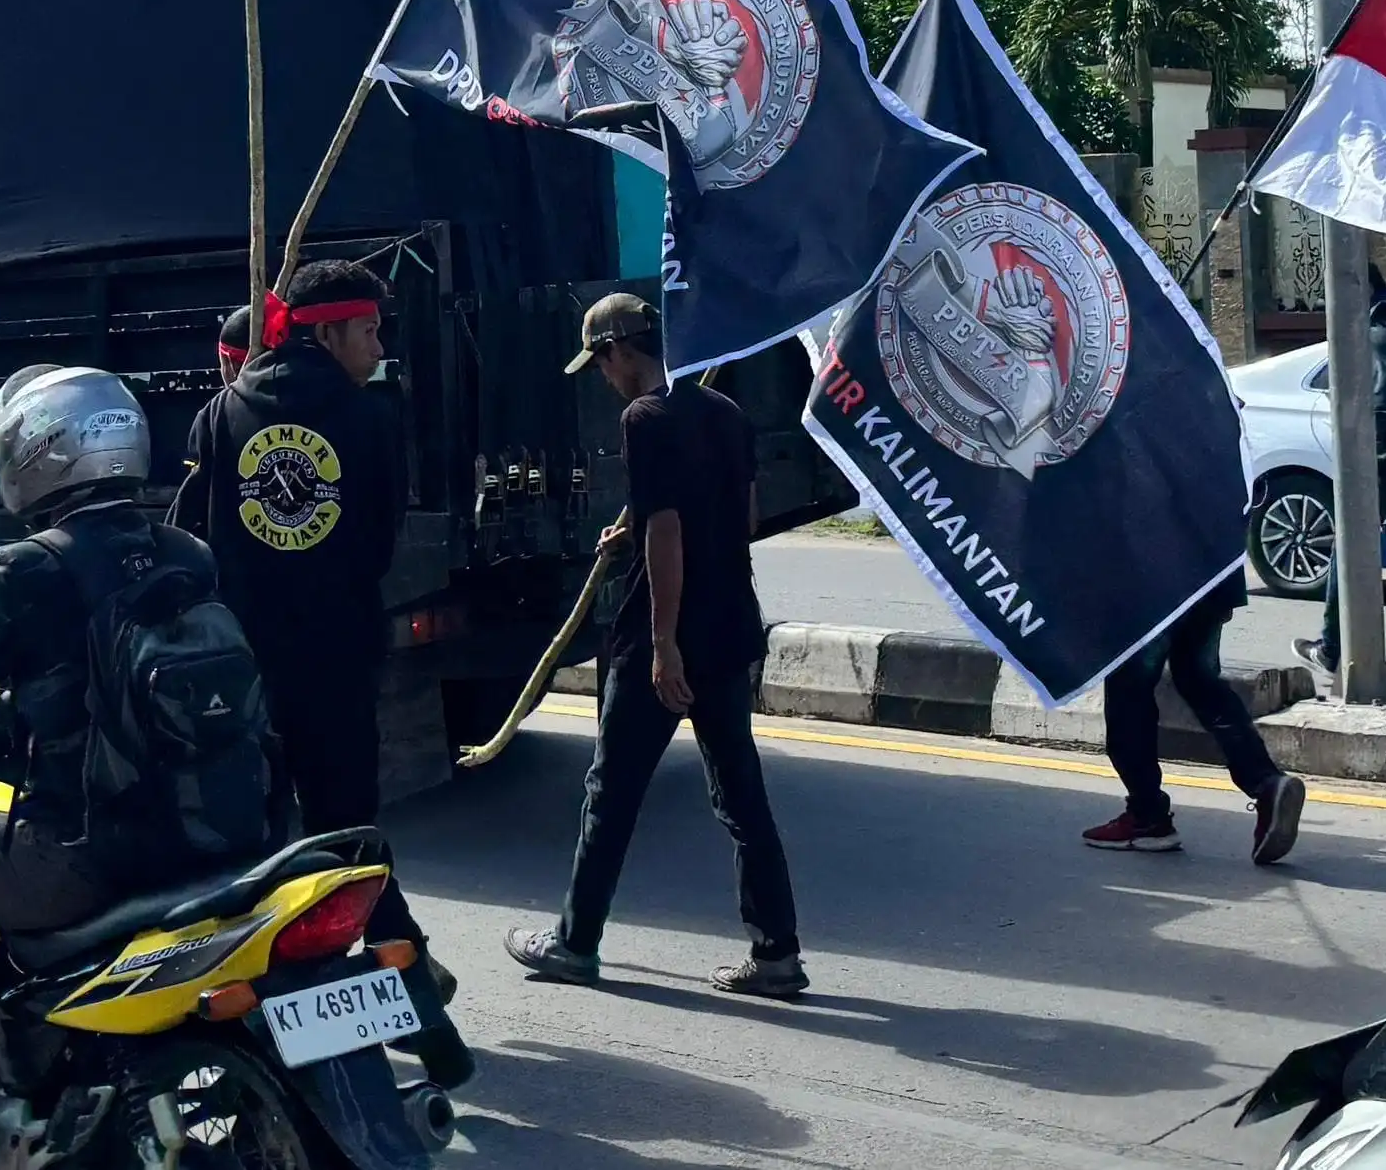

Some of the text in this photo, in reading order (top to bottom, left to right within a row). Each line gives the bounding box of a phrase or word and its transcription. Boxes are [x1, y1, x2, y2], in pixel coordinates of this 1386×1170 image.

[429, 47, 486, 111] DPD
[770, 14, 794, 99] TIMUR
[734, 101, 782, 157] RAYA
[1075, 304, 1102, 385] TIMUR
[248, 427, 331, 464] TIMUR
[248, 513, 288, 547] SATU
[292, 511, 332, 546] ASA
[854, 405, 1045, 638] KALIMANTAN
[273, 974, 405, 1032] KT 4697 MZ
